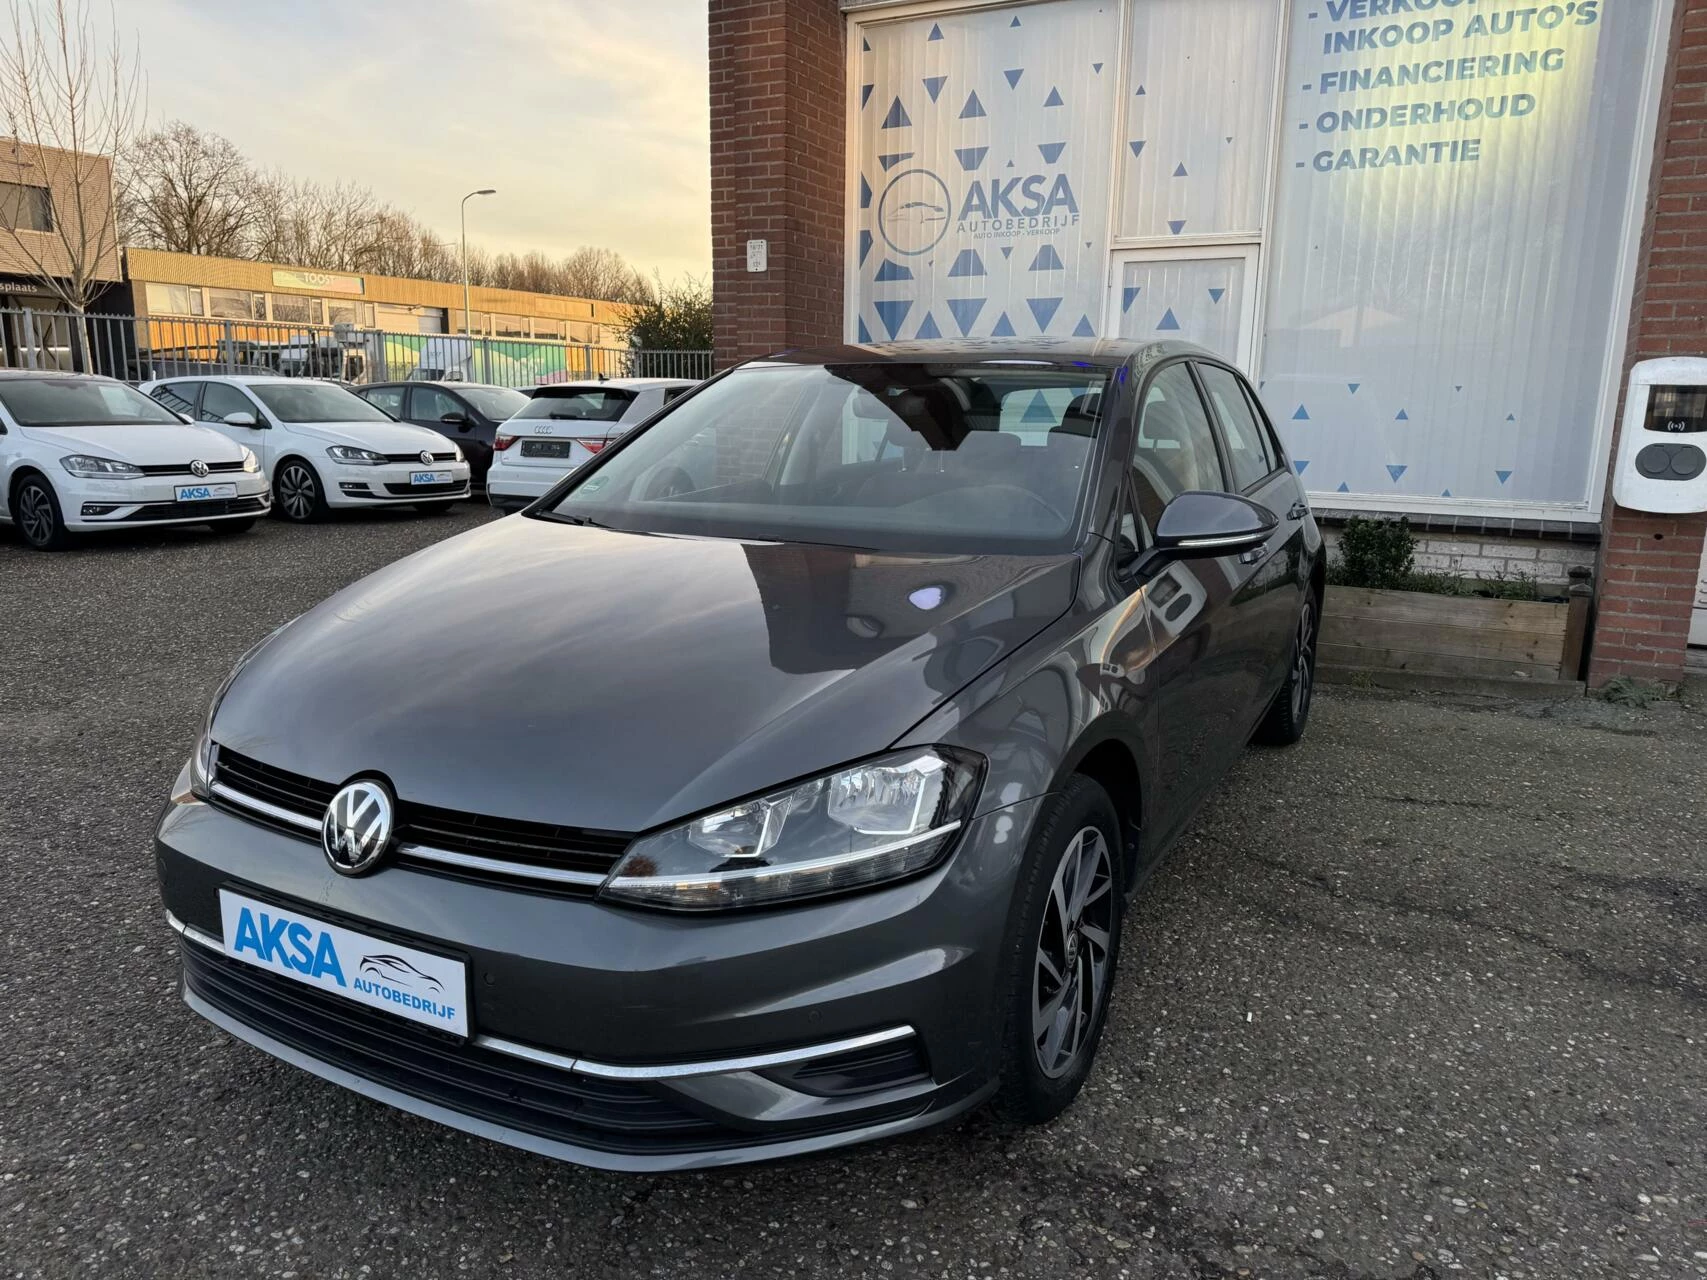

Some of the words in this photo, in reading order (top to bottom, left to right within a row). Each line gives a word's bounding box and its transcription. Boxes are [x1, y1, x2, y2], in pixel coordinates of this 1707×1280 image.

[1323, 18, 1454, 54] INKOOP
[1463, 0, 1598, 38] AUTO'S
[1326, 0, 1477, 22] VERK
[1320, 47, 1565, 94] FINANCIERING
[1316, 93, 1536, 133] ONDERHOUD
[1313, 138, 1481, 172] GARANTIE
[957, 173, 1079, 221] AKSA
[956, 214, 1080, 233] AUTOBEDRIJF
[180, 487, 212, 499] AKSA
[413, 473, 436, 483] AKSA
[234, 907, 347, 988] AKSA
[353, 976, 456, 1020] AUTOBEDRIJF
